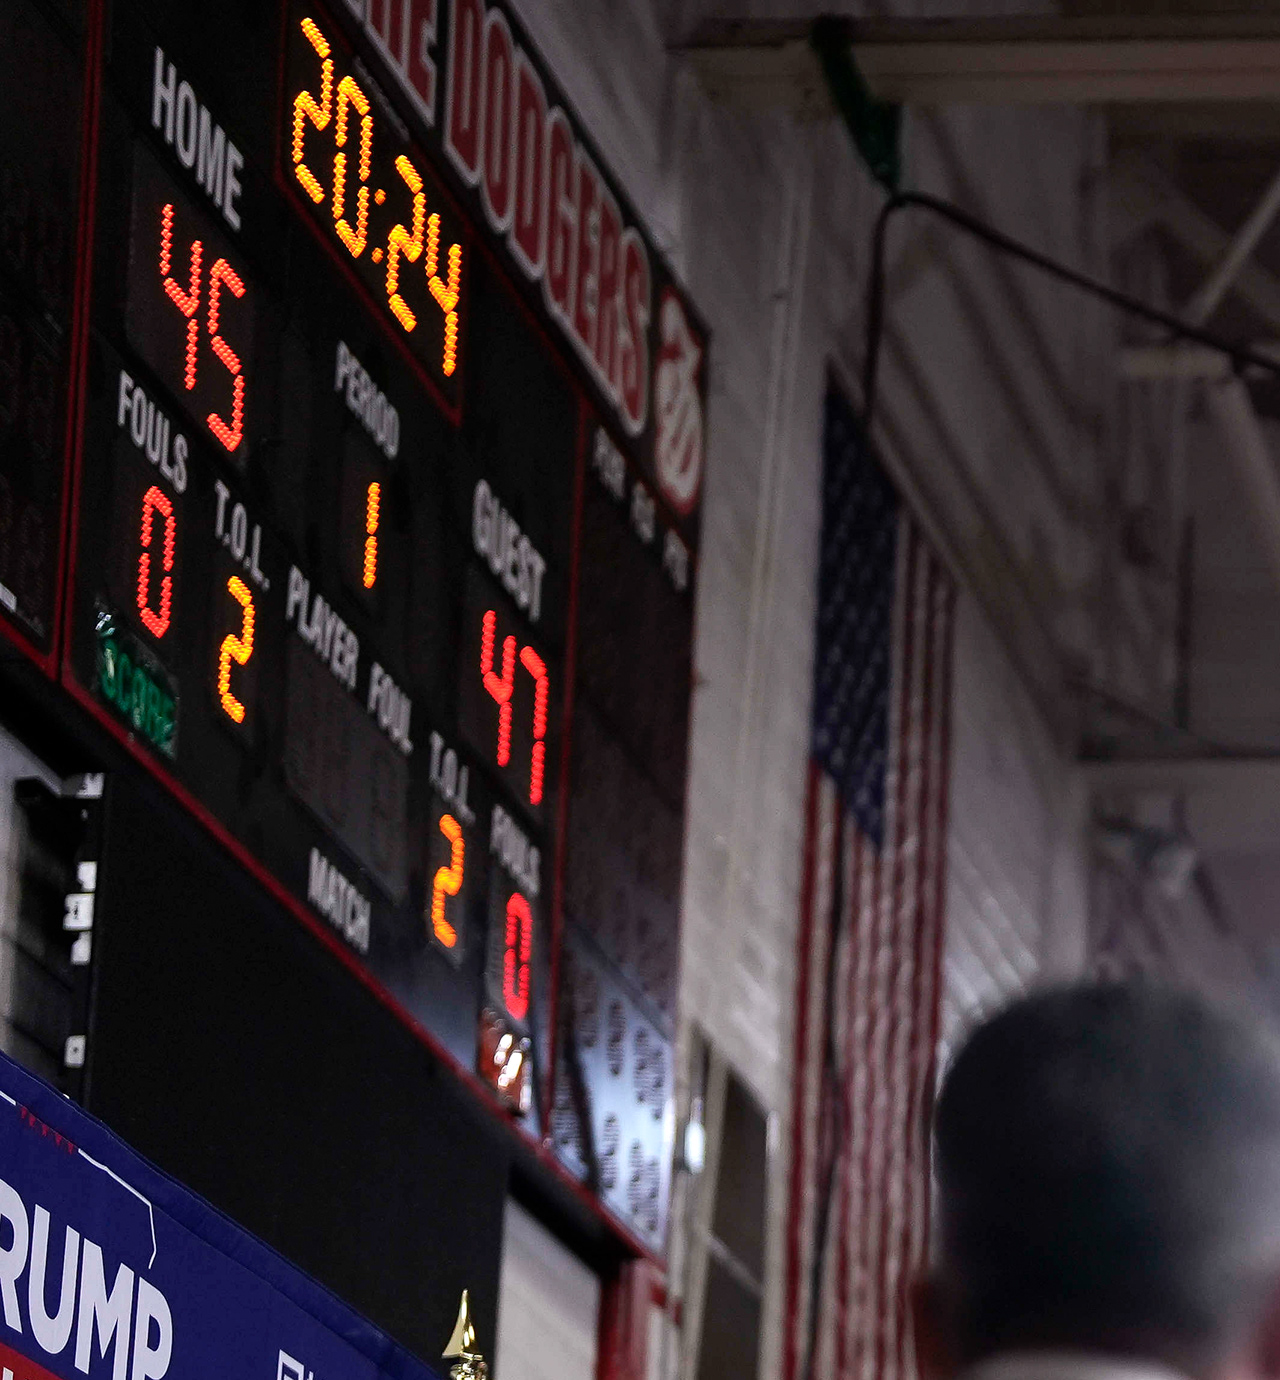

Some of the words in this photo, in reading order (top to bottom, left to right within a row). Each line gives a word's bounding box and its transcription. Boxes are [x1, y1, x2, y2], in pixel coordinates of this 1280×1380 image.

[151, 46, 244, 233] HOME
[292, 17, 462, 378] 20:24
[444, 0, 652, 438] DODGERS
[160, 203, 247, 452] 45
[118, 369, 190, 495] FOULS
[136, 485, 176, 638] 0
[214, 478, 270, 592] T.O.L.
[363, 482, 381, 589] 1
[471, 478, 547, 623] GUEST
[218, 575, 256, 723] 2
[285, 564, 360, 691] PLAYER
[480, 609, 549, 806] 47
[307, 846, 372, 955] MATCH
[431, 813, 466, 949] 2
[503, 892, 533, 1021] 0
